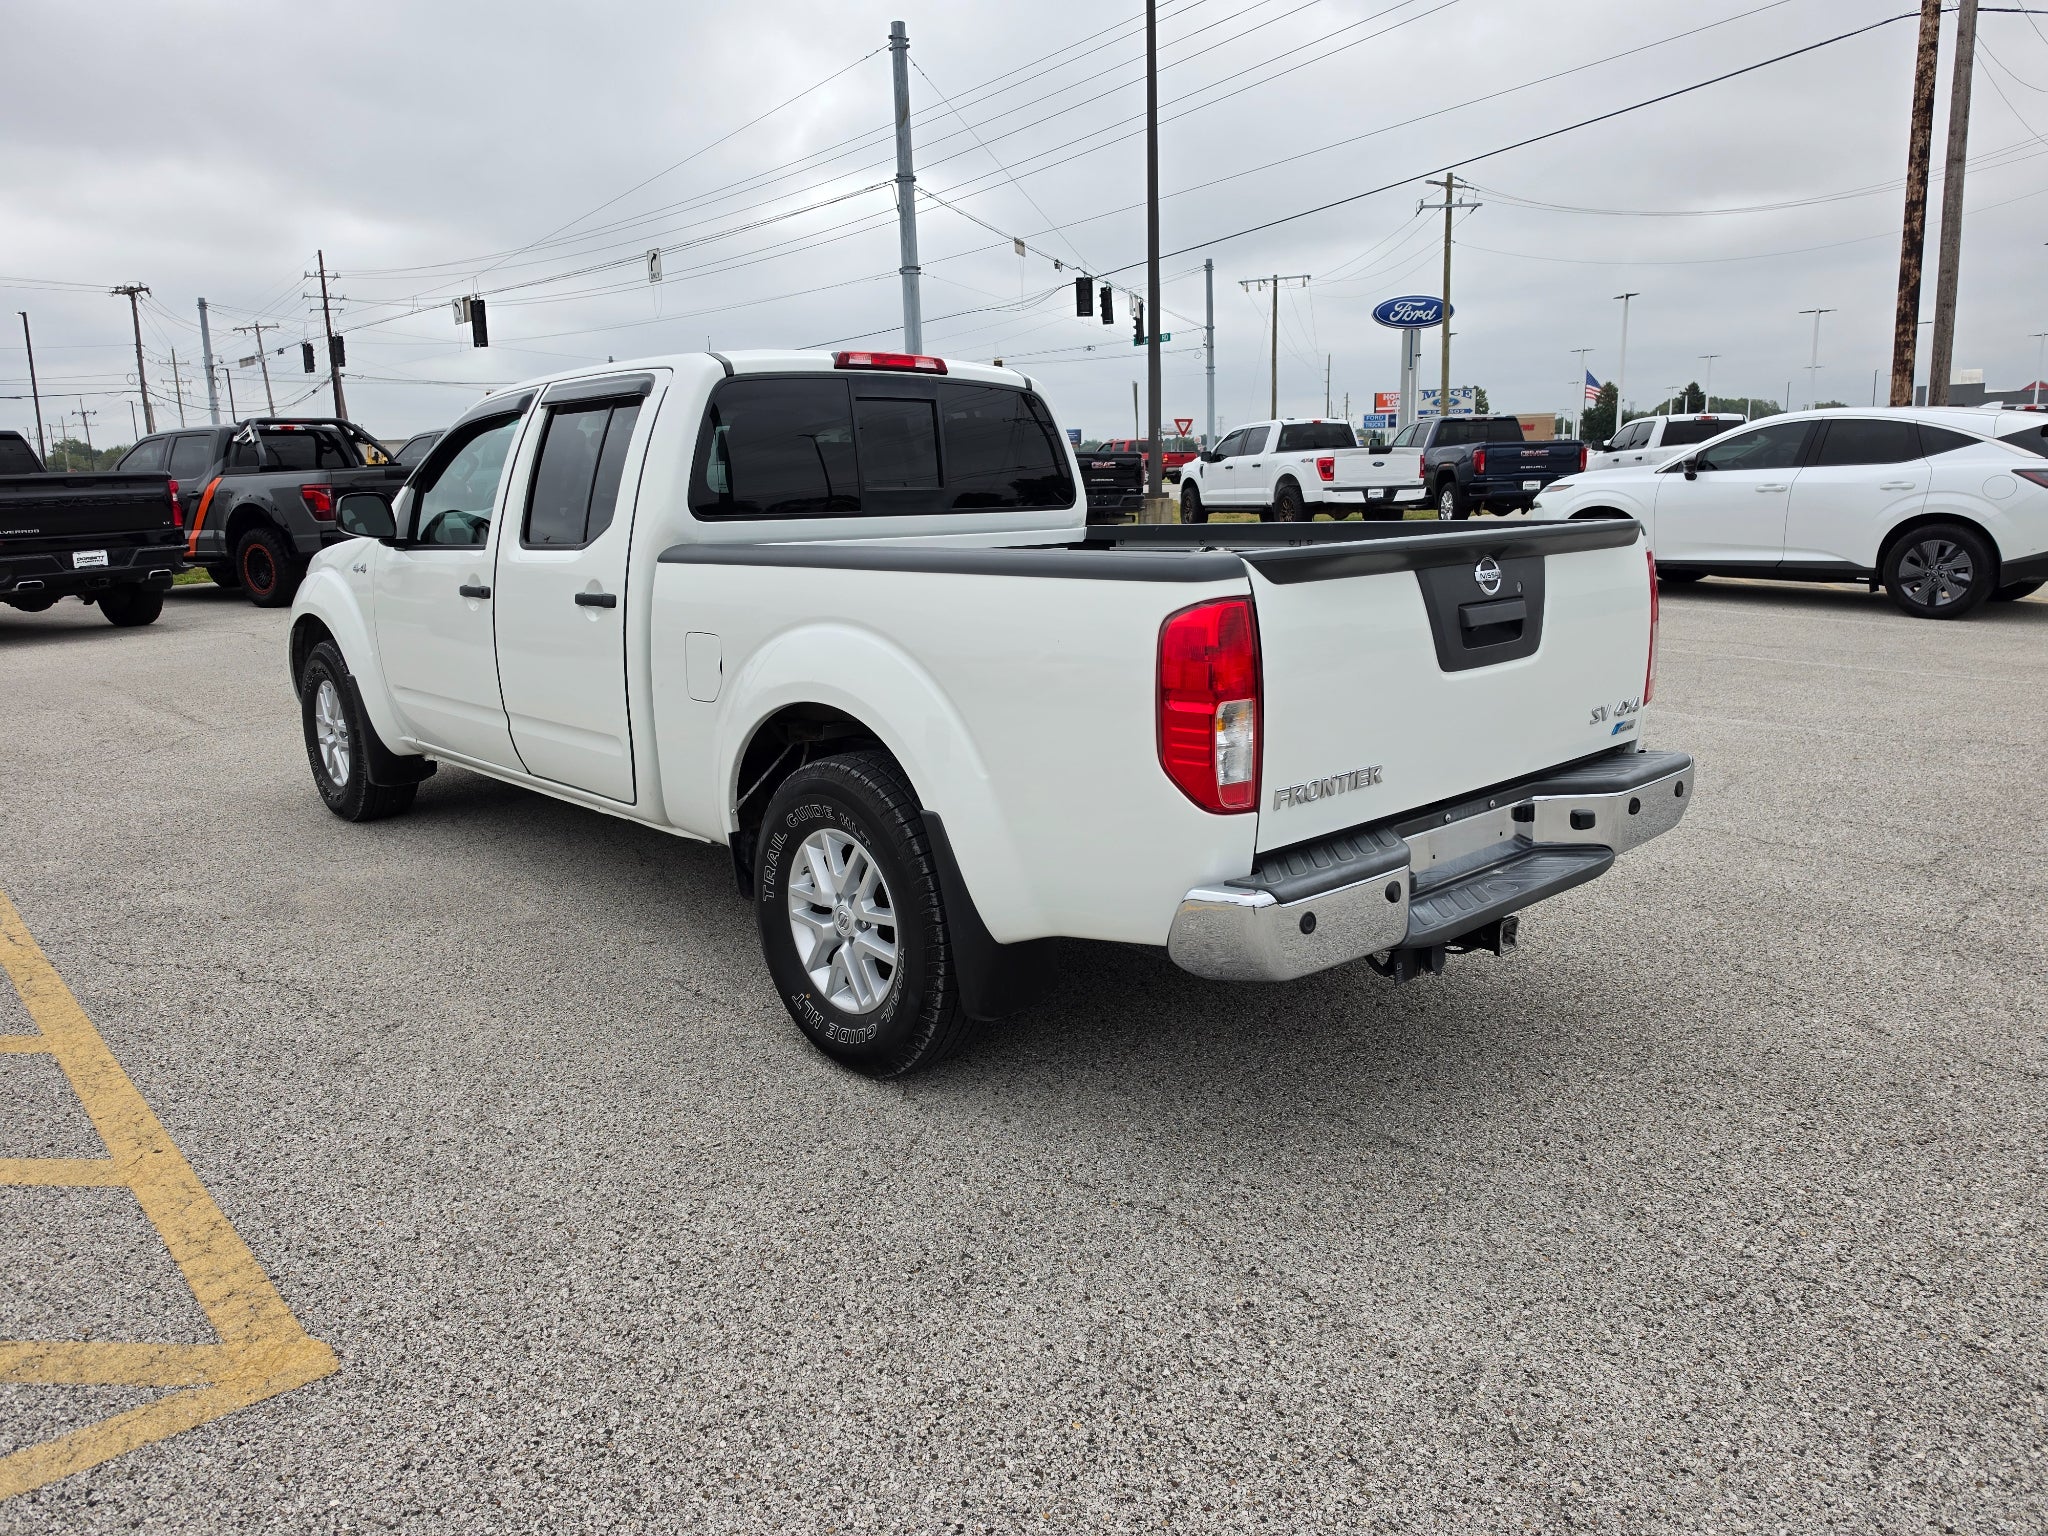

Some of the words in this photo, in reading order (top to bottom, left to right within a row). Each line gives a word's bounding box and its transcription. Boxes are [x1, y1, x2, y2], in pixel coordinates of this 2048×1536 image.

[1389, 301, 1438, 322] Ford
[1161, 334, 1169, 342] RD
[1589, 704, 1611, 725] SV
[1273, 764, 1383, 811] FRONTIER
[763, 832, 788, 902] TRAIL
[786, 804, 836, 828] GUIDE
[791, 993, 824, 1030] HLT
[825, 1022, 877, 1044] GUIDE
